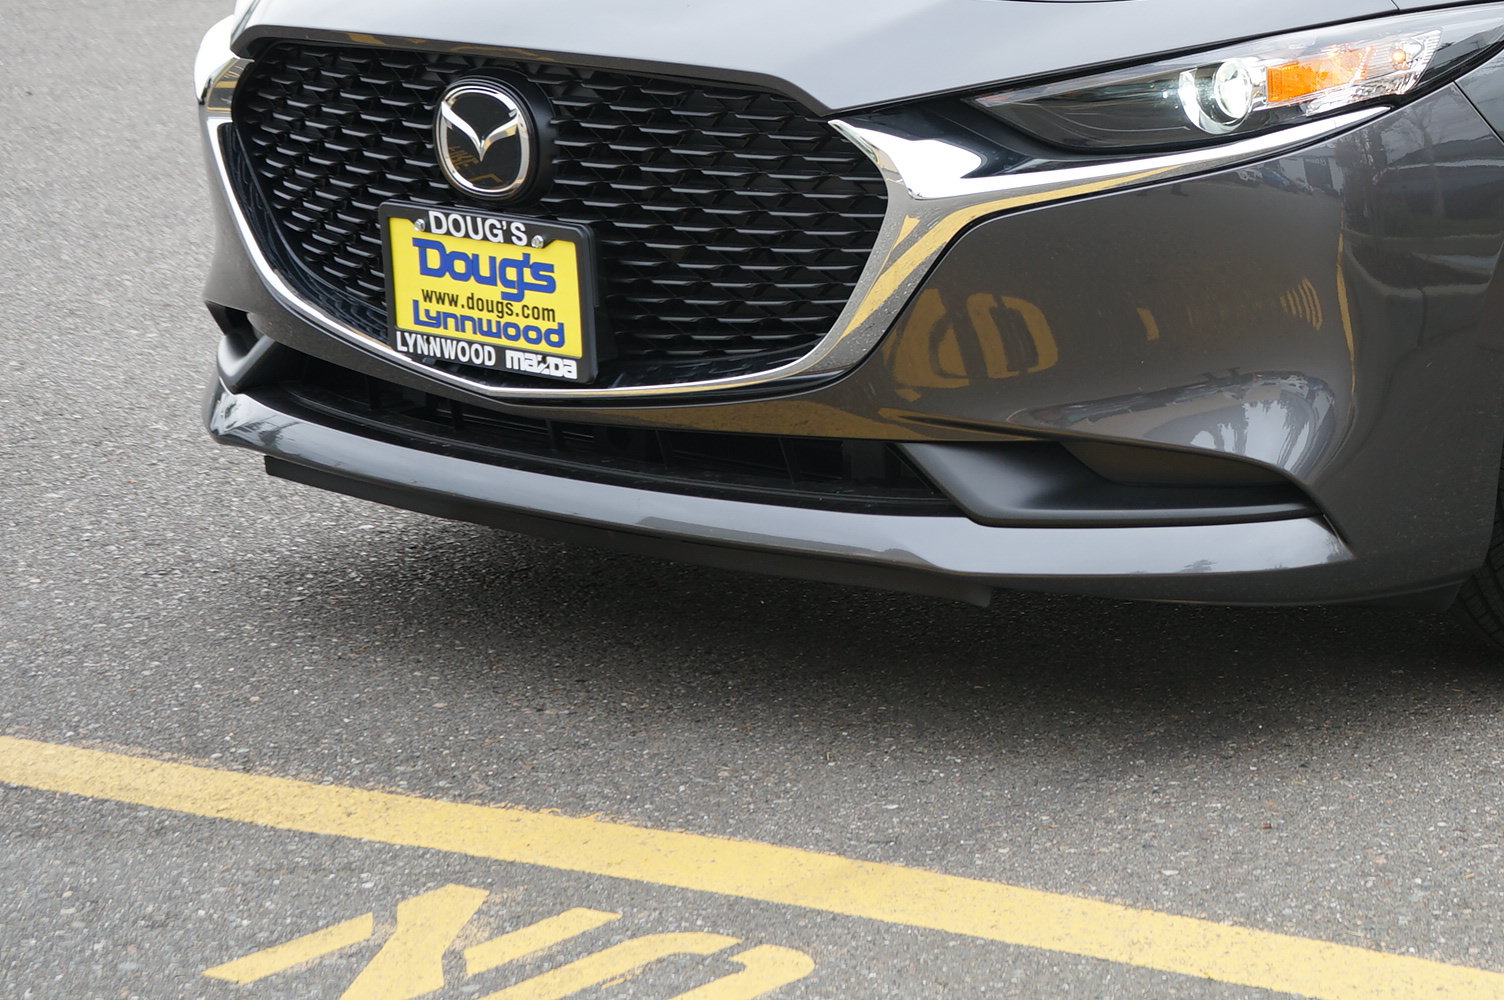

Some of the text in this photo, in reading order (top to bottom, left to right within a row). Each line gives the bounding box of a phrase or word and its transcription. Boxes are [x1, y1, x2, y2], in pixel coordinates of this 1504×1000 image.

[429, 212, 527, 246] DOUG'S
[422, 289, 555, 321] www.dougs.com
[413, 300, 564, 347] Lynnwood
[397, 332, 495, 366] LYNNWOOD
